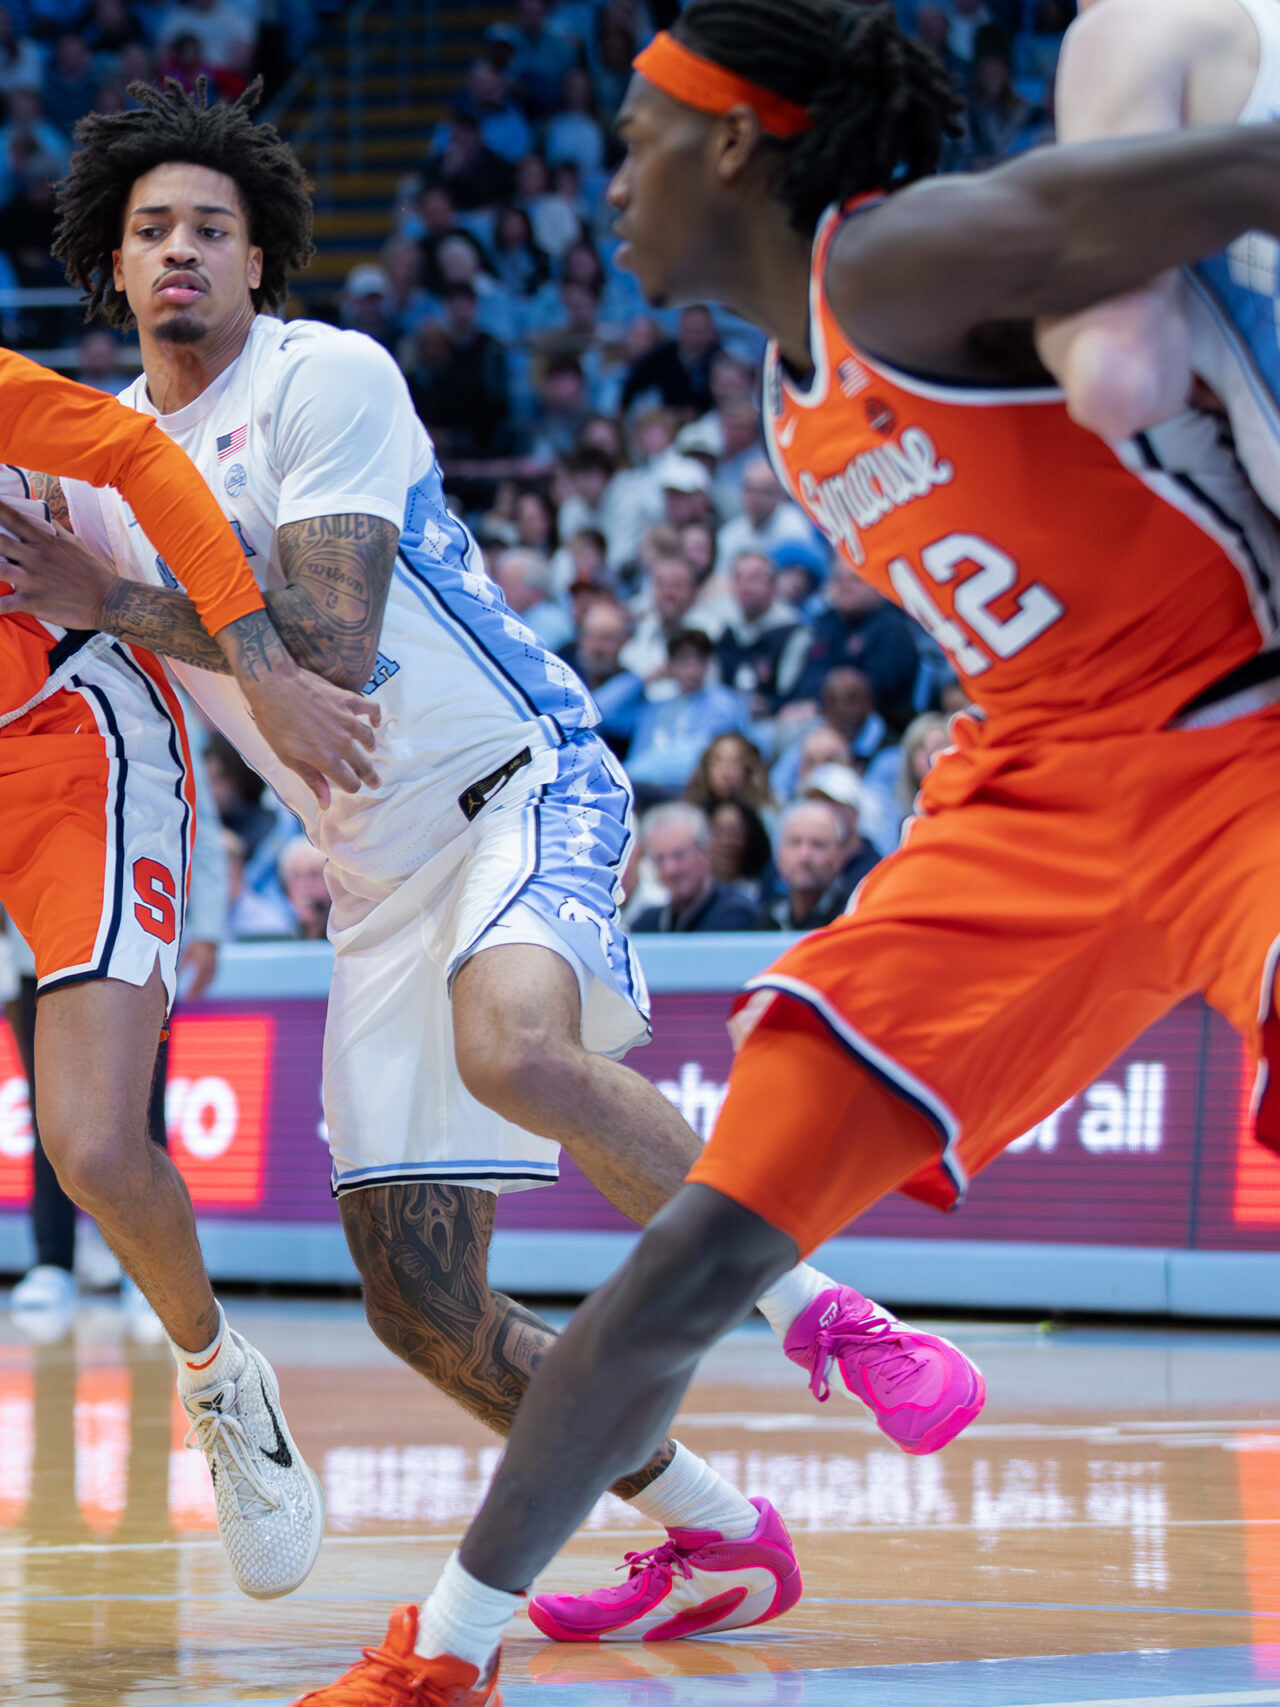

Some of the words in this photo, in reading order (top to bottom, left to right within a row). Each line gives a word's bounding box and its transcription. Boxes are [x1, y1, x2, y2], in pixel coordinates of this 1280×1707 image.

[887, 531, 1067, 678] 42
[132, 856, 176, 944] S
[1077, 1061, 1167, 1153] all
